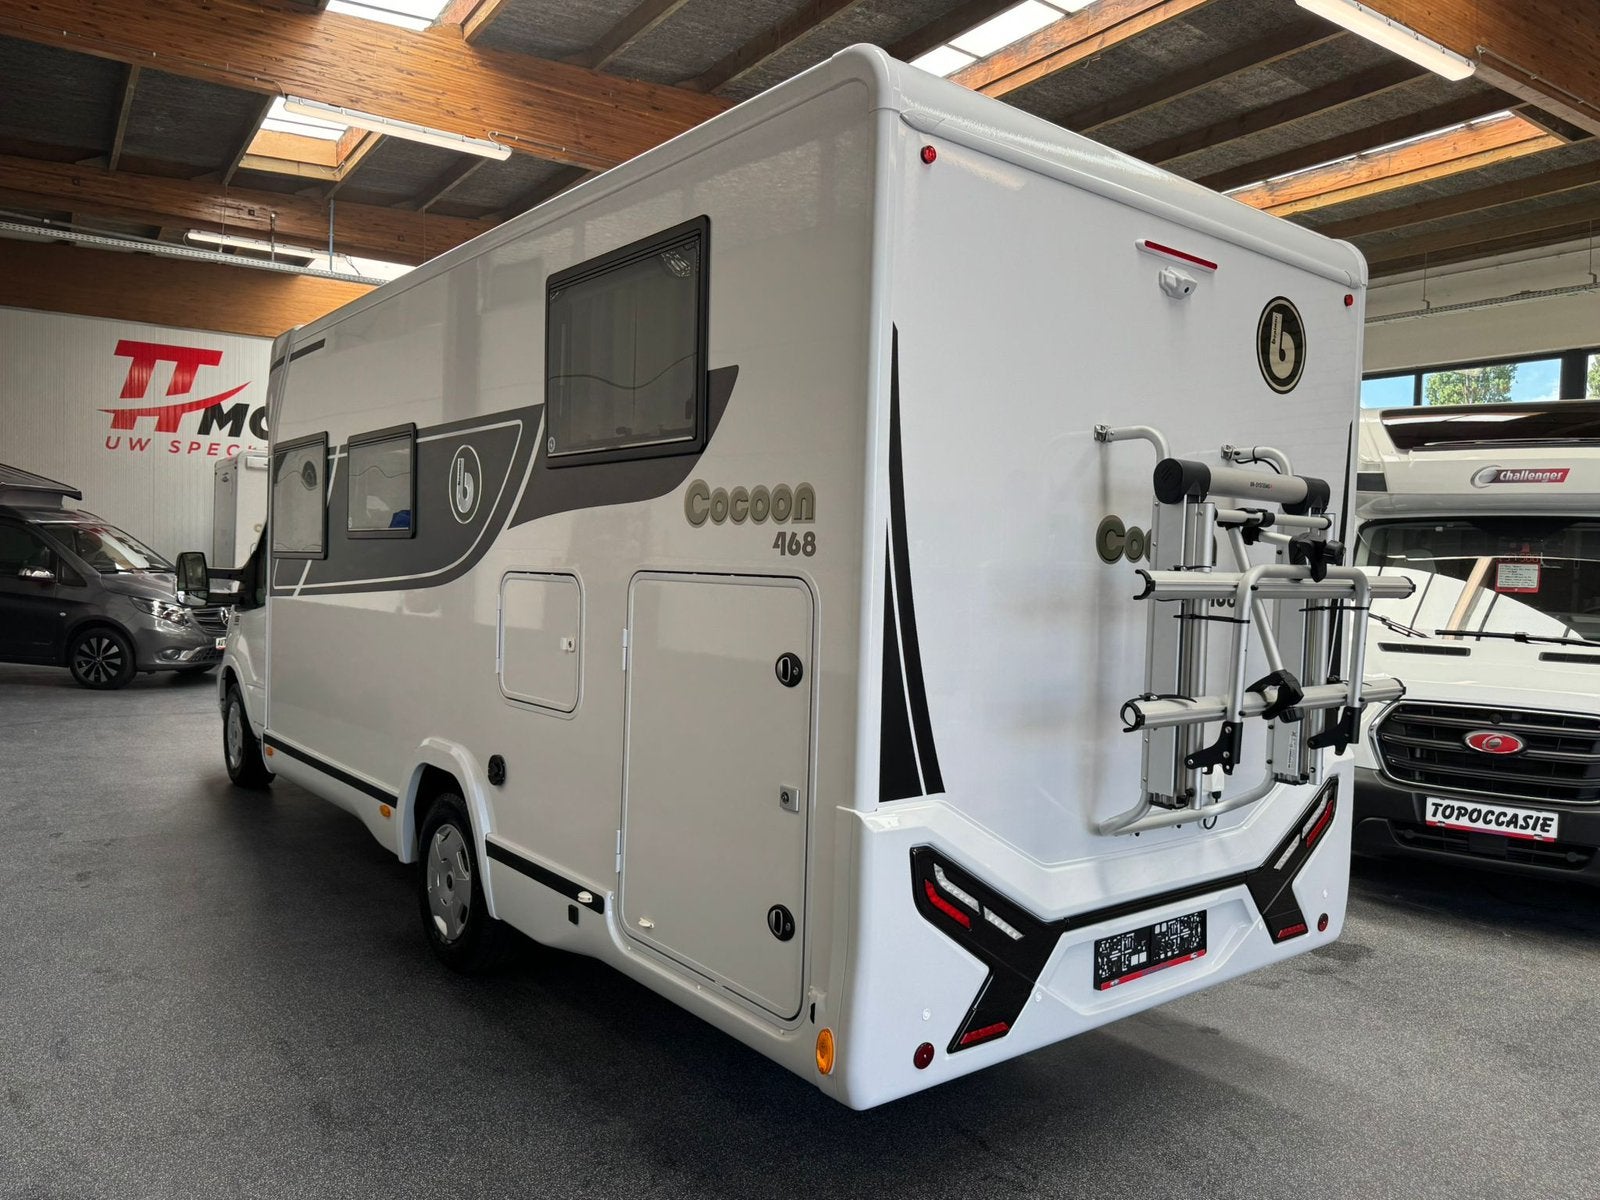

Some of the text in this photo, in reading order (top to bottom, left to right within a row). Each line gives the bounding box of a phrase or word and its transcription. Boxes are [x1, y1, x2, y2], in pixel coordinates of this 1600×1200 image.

[105, 436, 152, 452] UW
[1499, 470, 1564, 483] Challenger
[684, 479, 816, 528] Cocoon
[772, 531, 817, 557] 468
[1431, 802, 1555, 833] TOPOCCASIE
